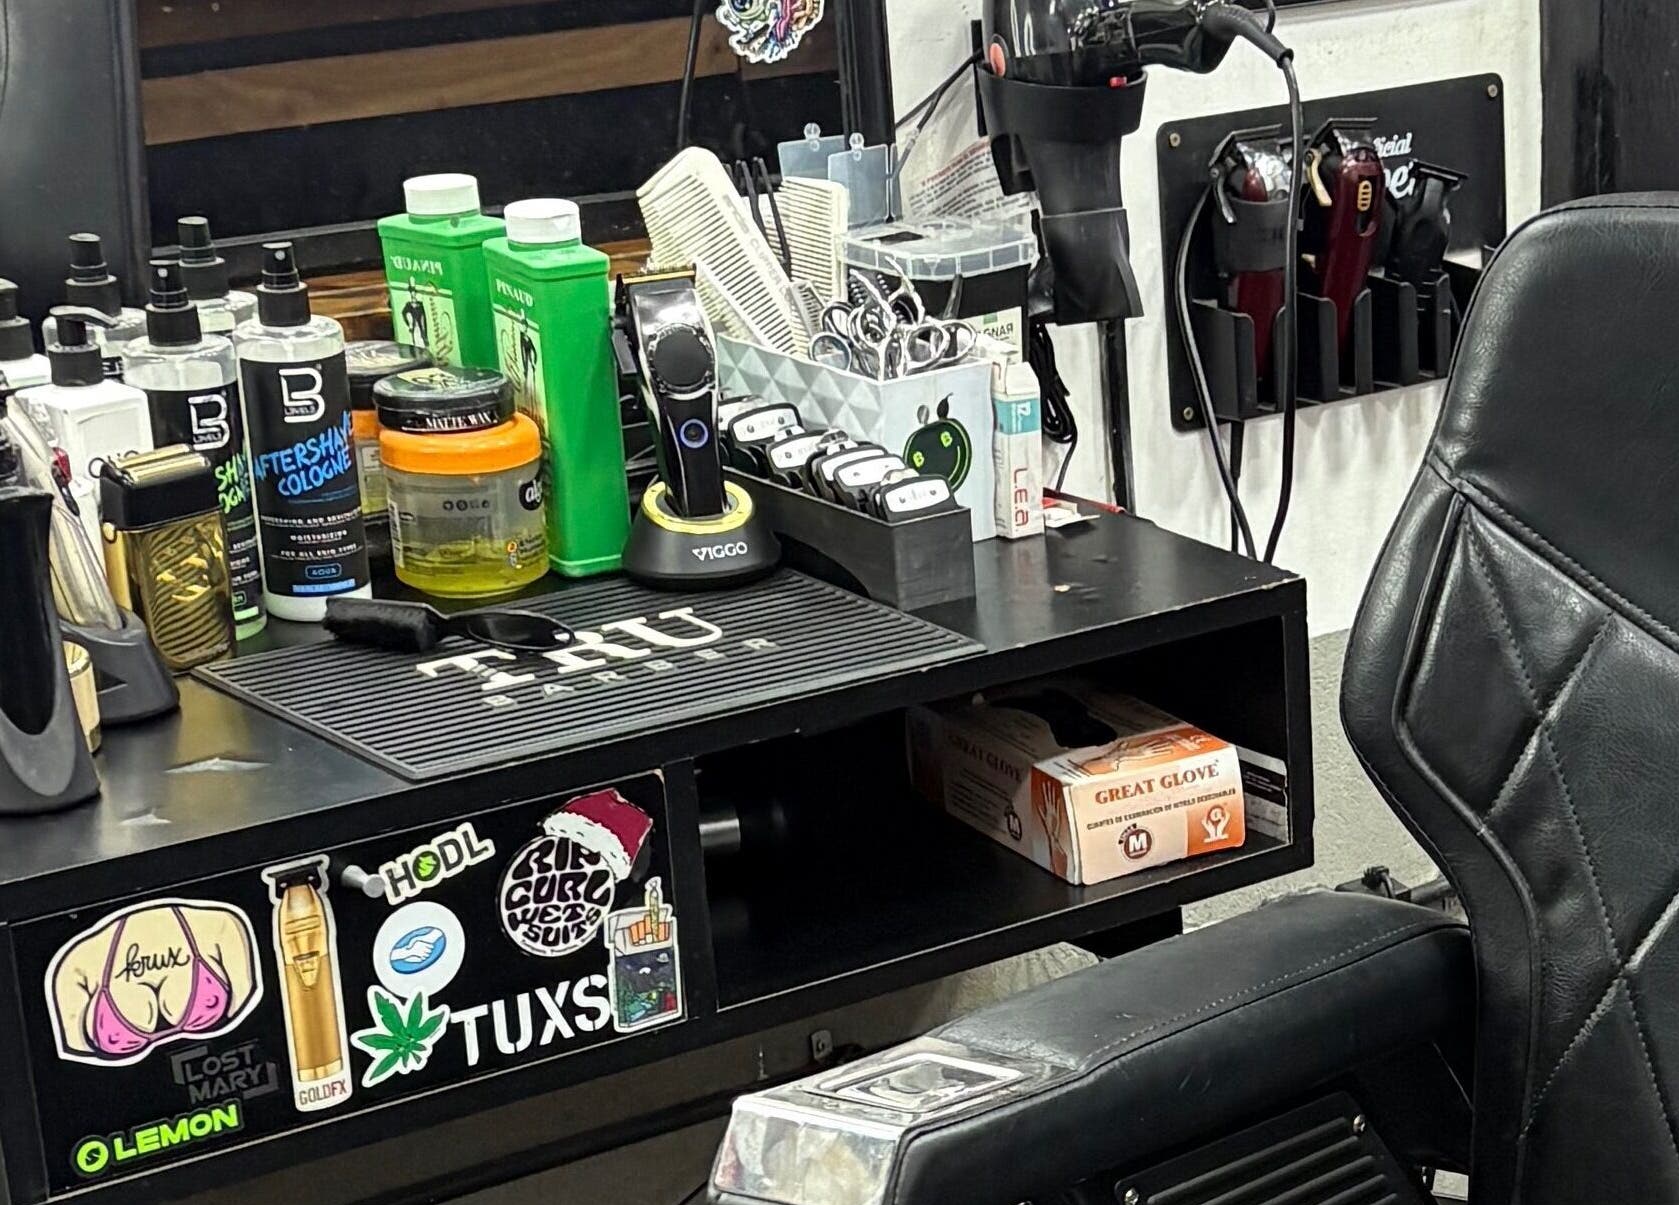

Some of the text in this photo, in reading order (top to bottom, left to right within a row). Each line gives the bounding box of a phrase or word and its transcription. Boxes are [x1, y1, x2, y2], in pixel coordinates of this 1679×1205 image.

[496, 278, 534, 307] PINAUD
[425, 416, 467, 429] MATTE
[278, 449, 352, 496] COLOGNE
[692, 541, 748, 561] VIGGO
[482, 637, 778, 708] BARBER
[1094, 778, 1156, 805] GREAT
[1159, 763, 1219, 790] GLOVE
[385, 829, 490, 898] HODL
[1128, 833, 1148, 853] M
[505, 869, 612, 912] CURL
[450, 973, 612, 1067] TUXS
[185, 1043, 256, 1083] LOST
[187, 1062, 263, 1105] MARY
[299, 1079, 347, 1105] GOLDFX
[113, 1103, 240, 1161] LEMON
